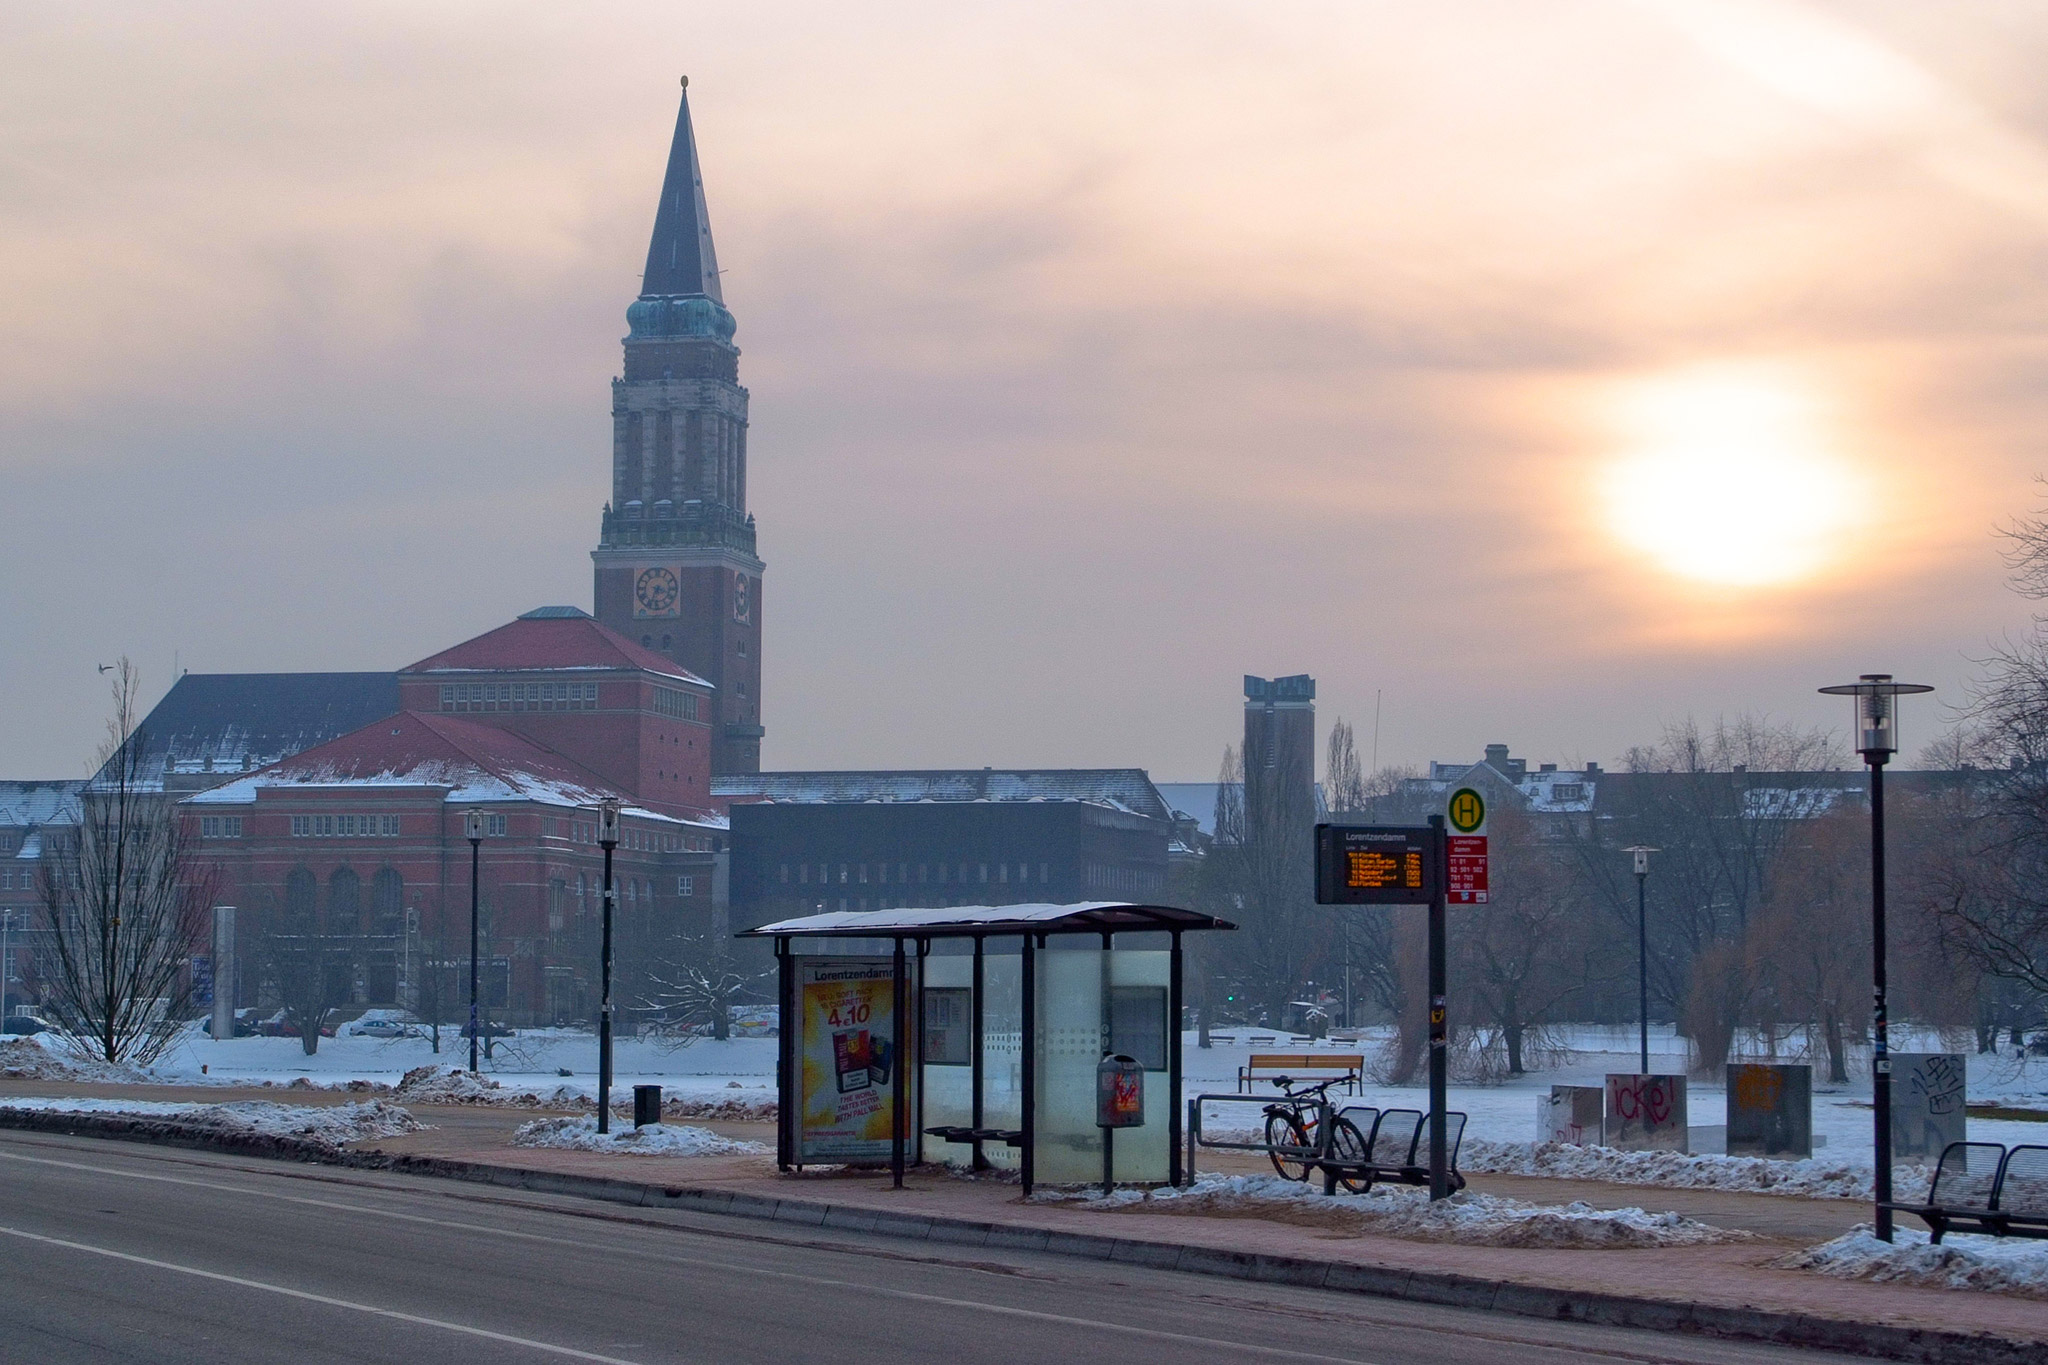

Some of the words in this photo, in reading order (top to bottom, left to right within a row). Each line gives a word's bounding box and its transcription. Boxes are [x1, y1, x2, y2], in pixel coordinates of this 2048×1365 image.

[1459, 799, 1474, 823] H
[1345, 833, 1406, 841] Lorentzendamm
[837, 1101, 859, 1112] TASTES
[860, 1096, 880, 1107] BETTER
[840, 1094, 853, 1104] THE
[855, 1090, 878, 1101] WORLD
[834, 1112, 852, 1124] WITH
[853, 1107, 868, 1118] PALL
[869, 1103, 885, 1113] MALL
